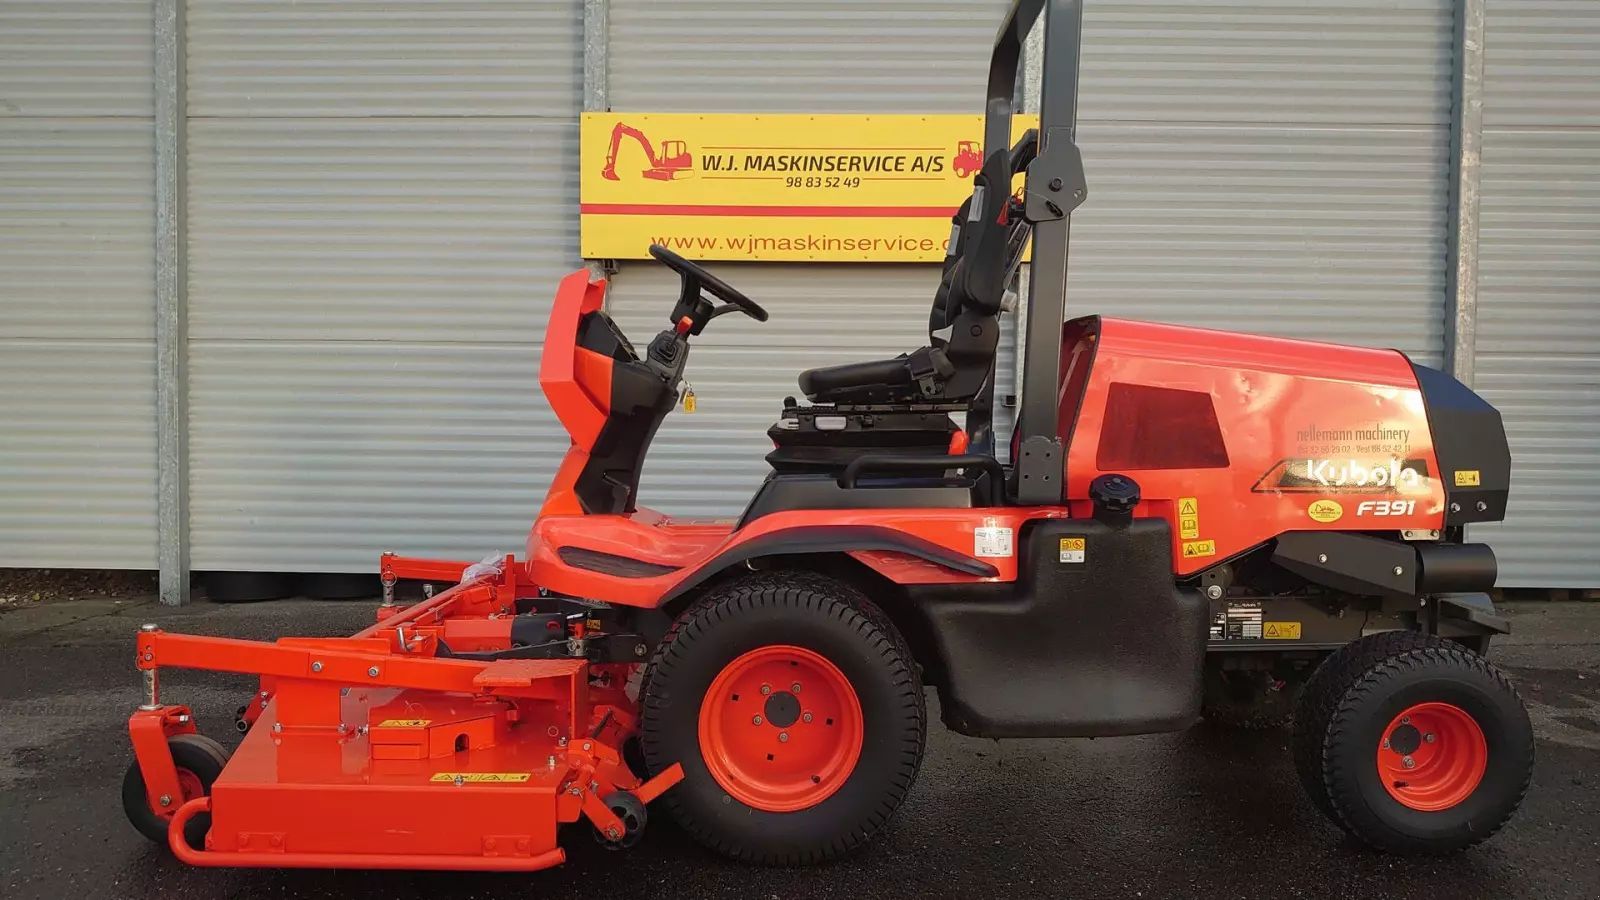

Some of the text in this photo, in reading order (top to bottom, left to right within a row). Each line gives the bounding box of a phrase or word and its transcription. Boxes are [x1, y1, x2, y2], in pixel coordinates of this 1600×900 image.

[702, 155, 944, 173] W.J. MASKINSERVICE A/S
[786, 177, 860, 188] 98 83 52 49
[1297, 423, 1410, 444] nellemann machinery
[1357, 500, 1416, 516] F391
